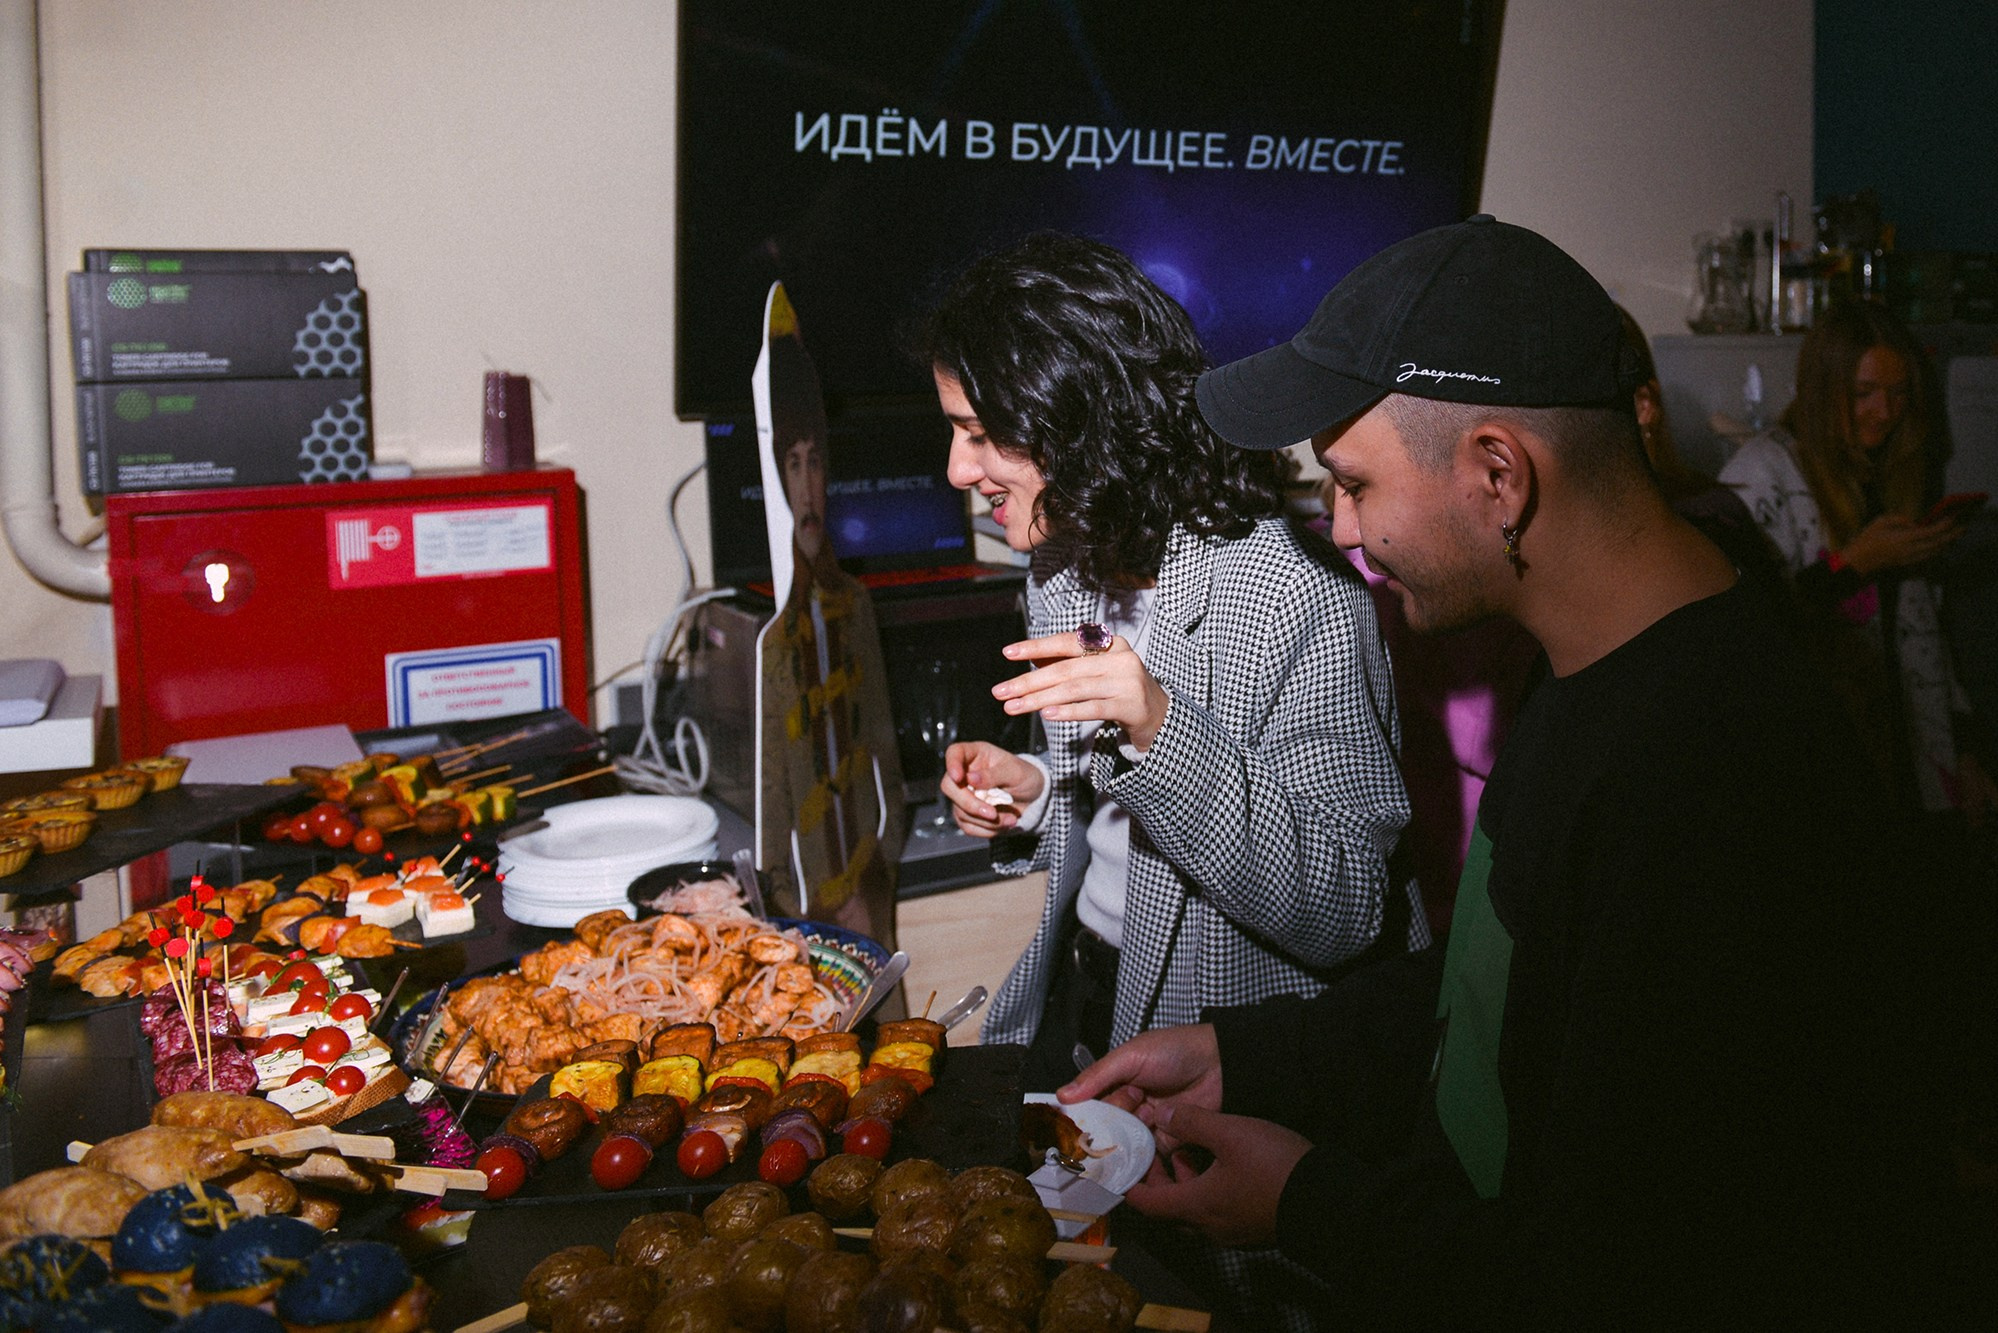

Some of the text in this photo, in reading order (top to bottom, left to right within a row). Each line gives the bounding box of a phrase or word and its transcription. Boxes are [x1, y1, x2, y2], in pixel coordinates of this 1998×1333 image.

[795, 108, 1405, 175] ИДЁМ В БУДУЩЕЕ. ВМЕСТЕ.
